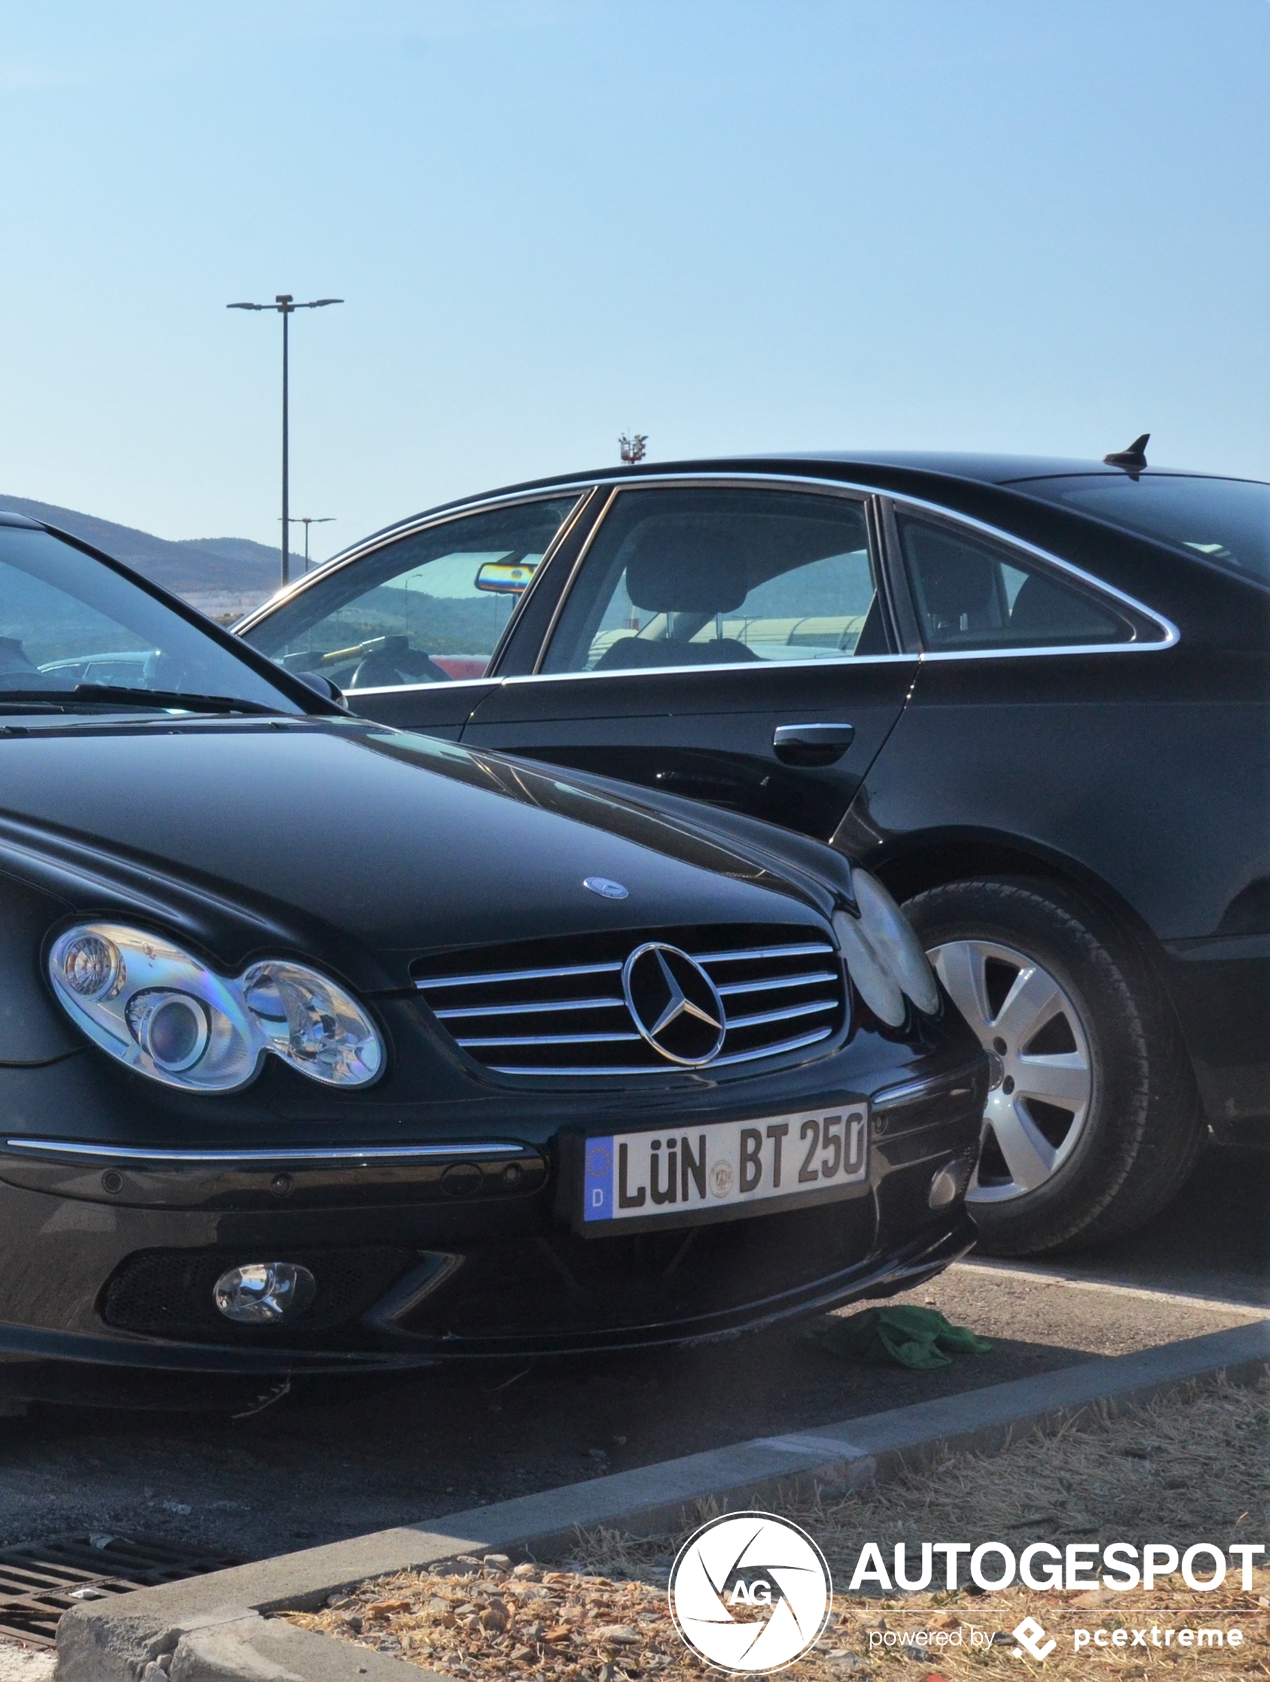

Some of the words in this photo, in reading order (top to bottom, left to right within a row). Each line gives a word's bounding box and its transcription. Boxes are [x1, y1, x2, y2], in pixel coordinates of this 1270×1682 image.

[739, 1123, 789, 1193] BT
[798, 1112, 864, 1183] 250
[592, 1188, 604, 1208] D
